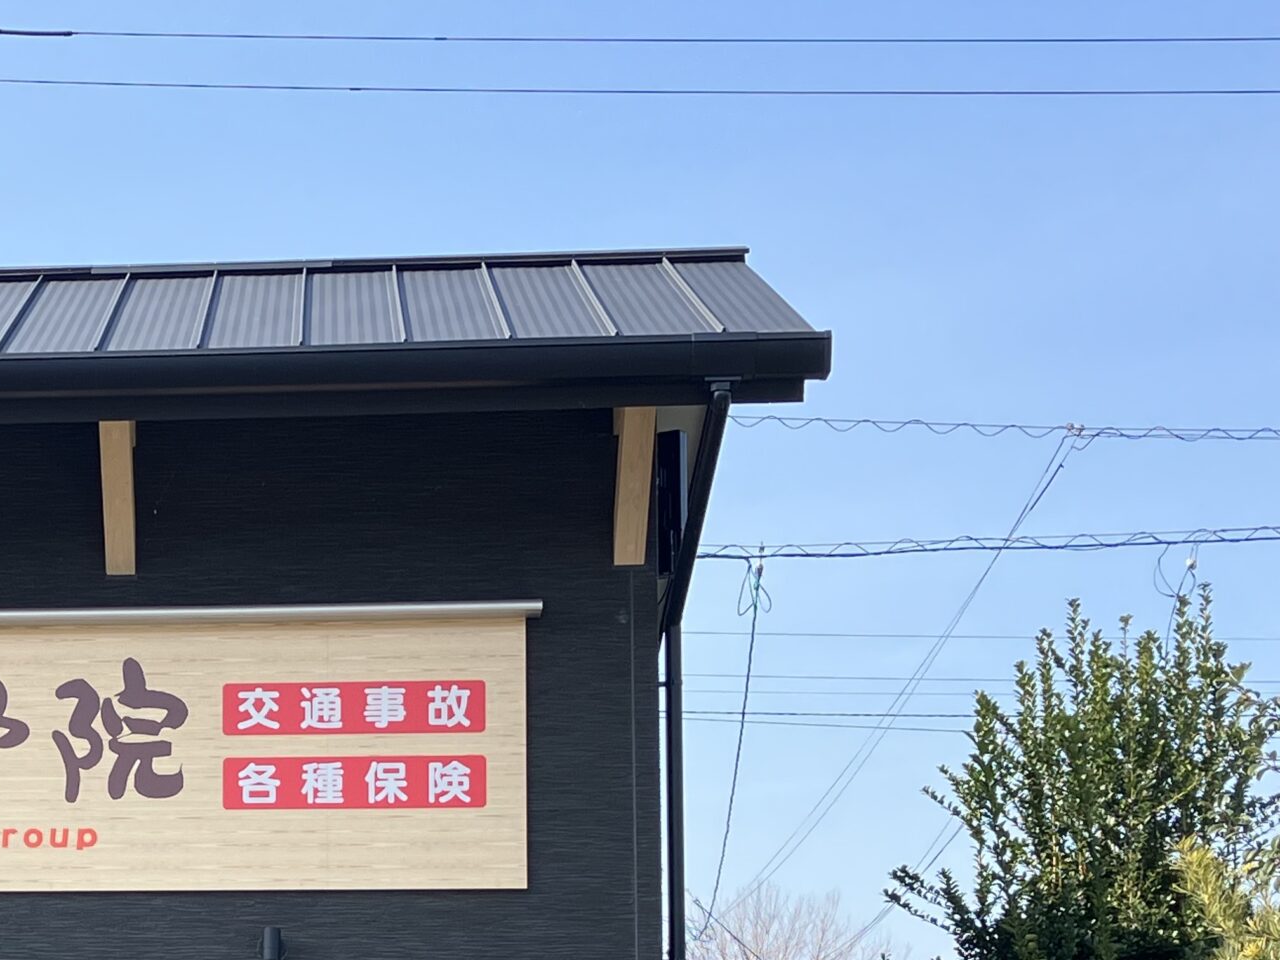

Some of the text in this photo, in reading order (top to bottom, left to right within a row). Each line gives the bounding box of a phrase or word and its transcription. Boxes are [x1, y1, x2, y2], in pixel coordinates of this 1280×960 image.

[237, 685, 471, 731] 交通事故
[237, 760, 471, 805] 各種保険
